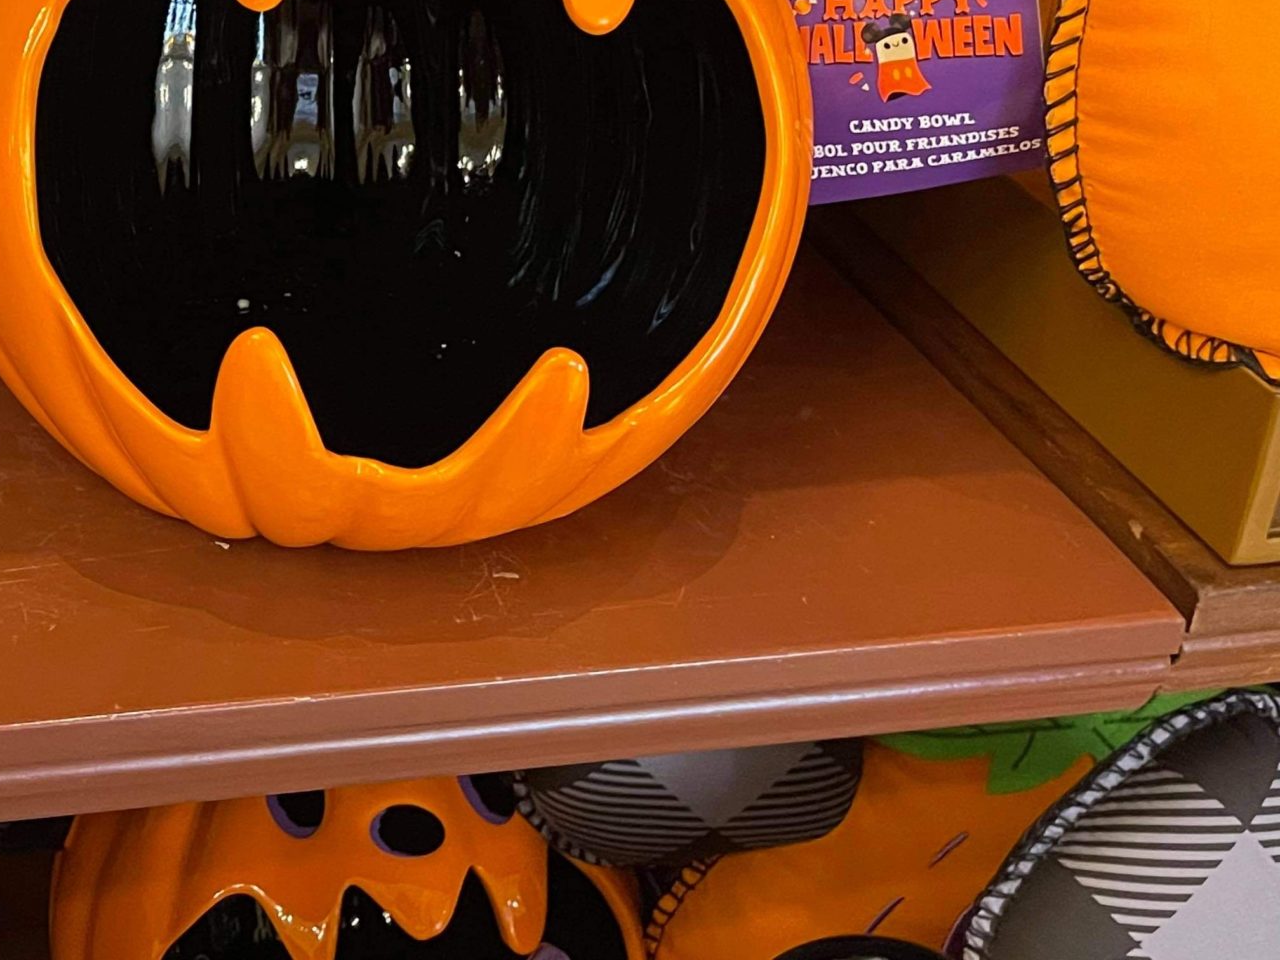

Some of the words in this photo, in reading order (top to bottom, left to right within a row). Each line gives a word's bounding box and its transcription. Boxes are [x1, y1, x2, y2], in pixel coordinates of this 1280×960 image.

[799, 13, 1024, 65] ALLWEEN
[849, 117, 914, 134] CANDY
[918, 113, 976, 129] BOWL
[813, 144, 848, 158] BOL
[851, 139, 902, 156] POUR
[905, 126, 1020, 152] FRIANDISES
[872, 157, 924, 174] PARA
[927, 138, 1043, 167] CARAMELOS
